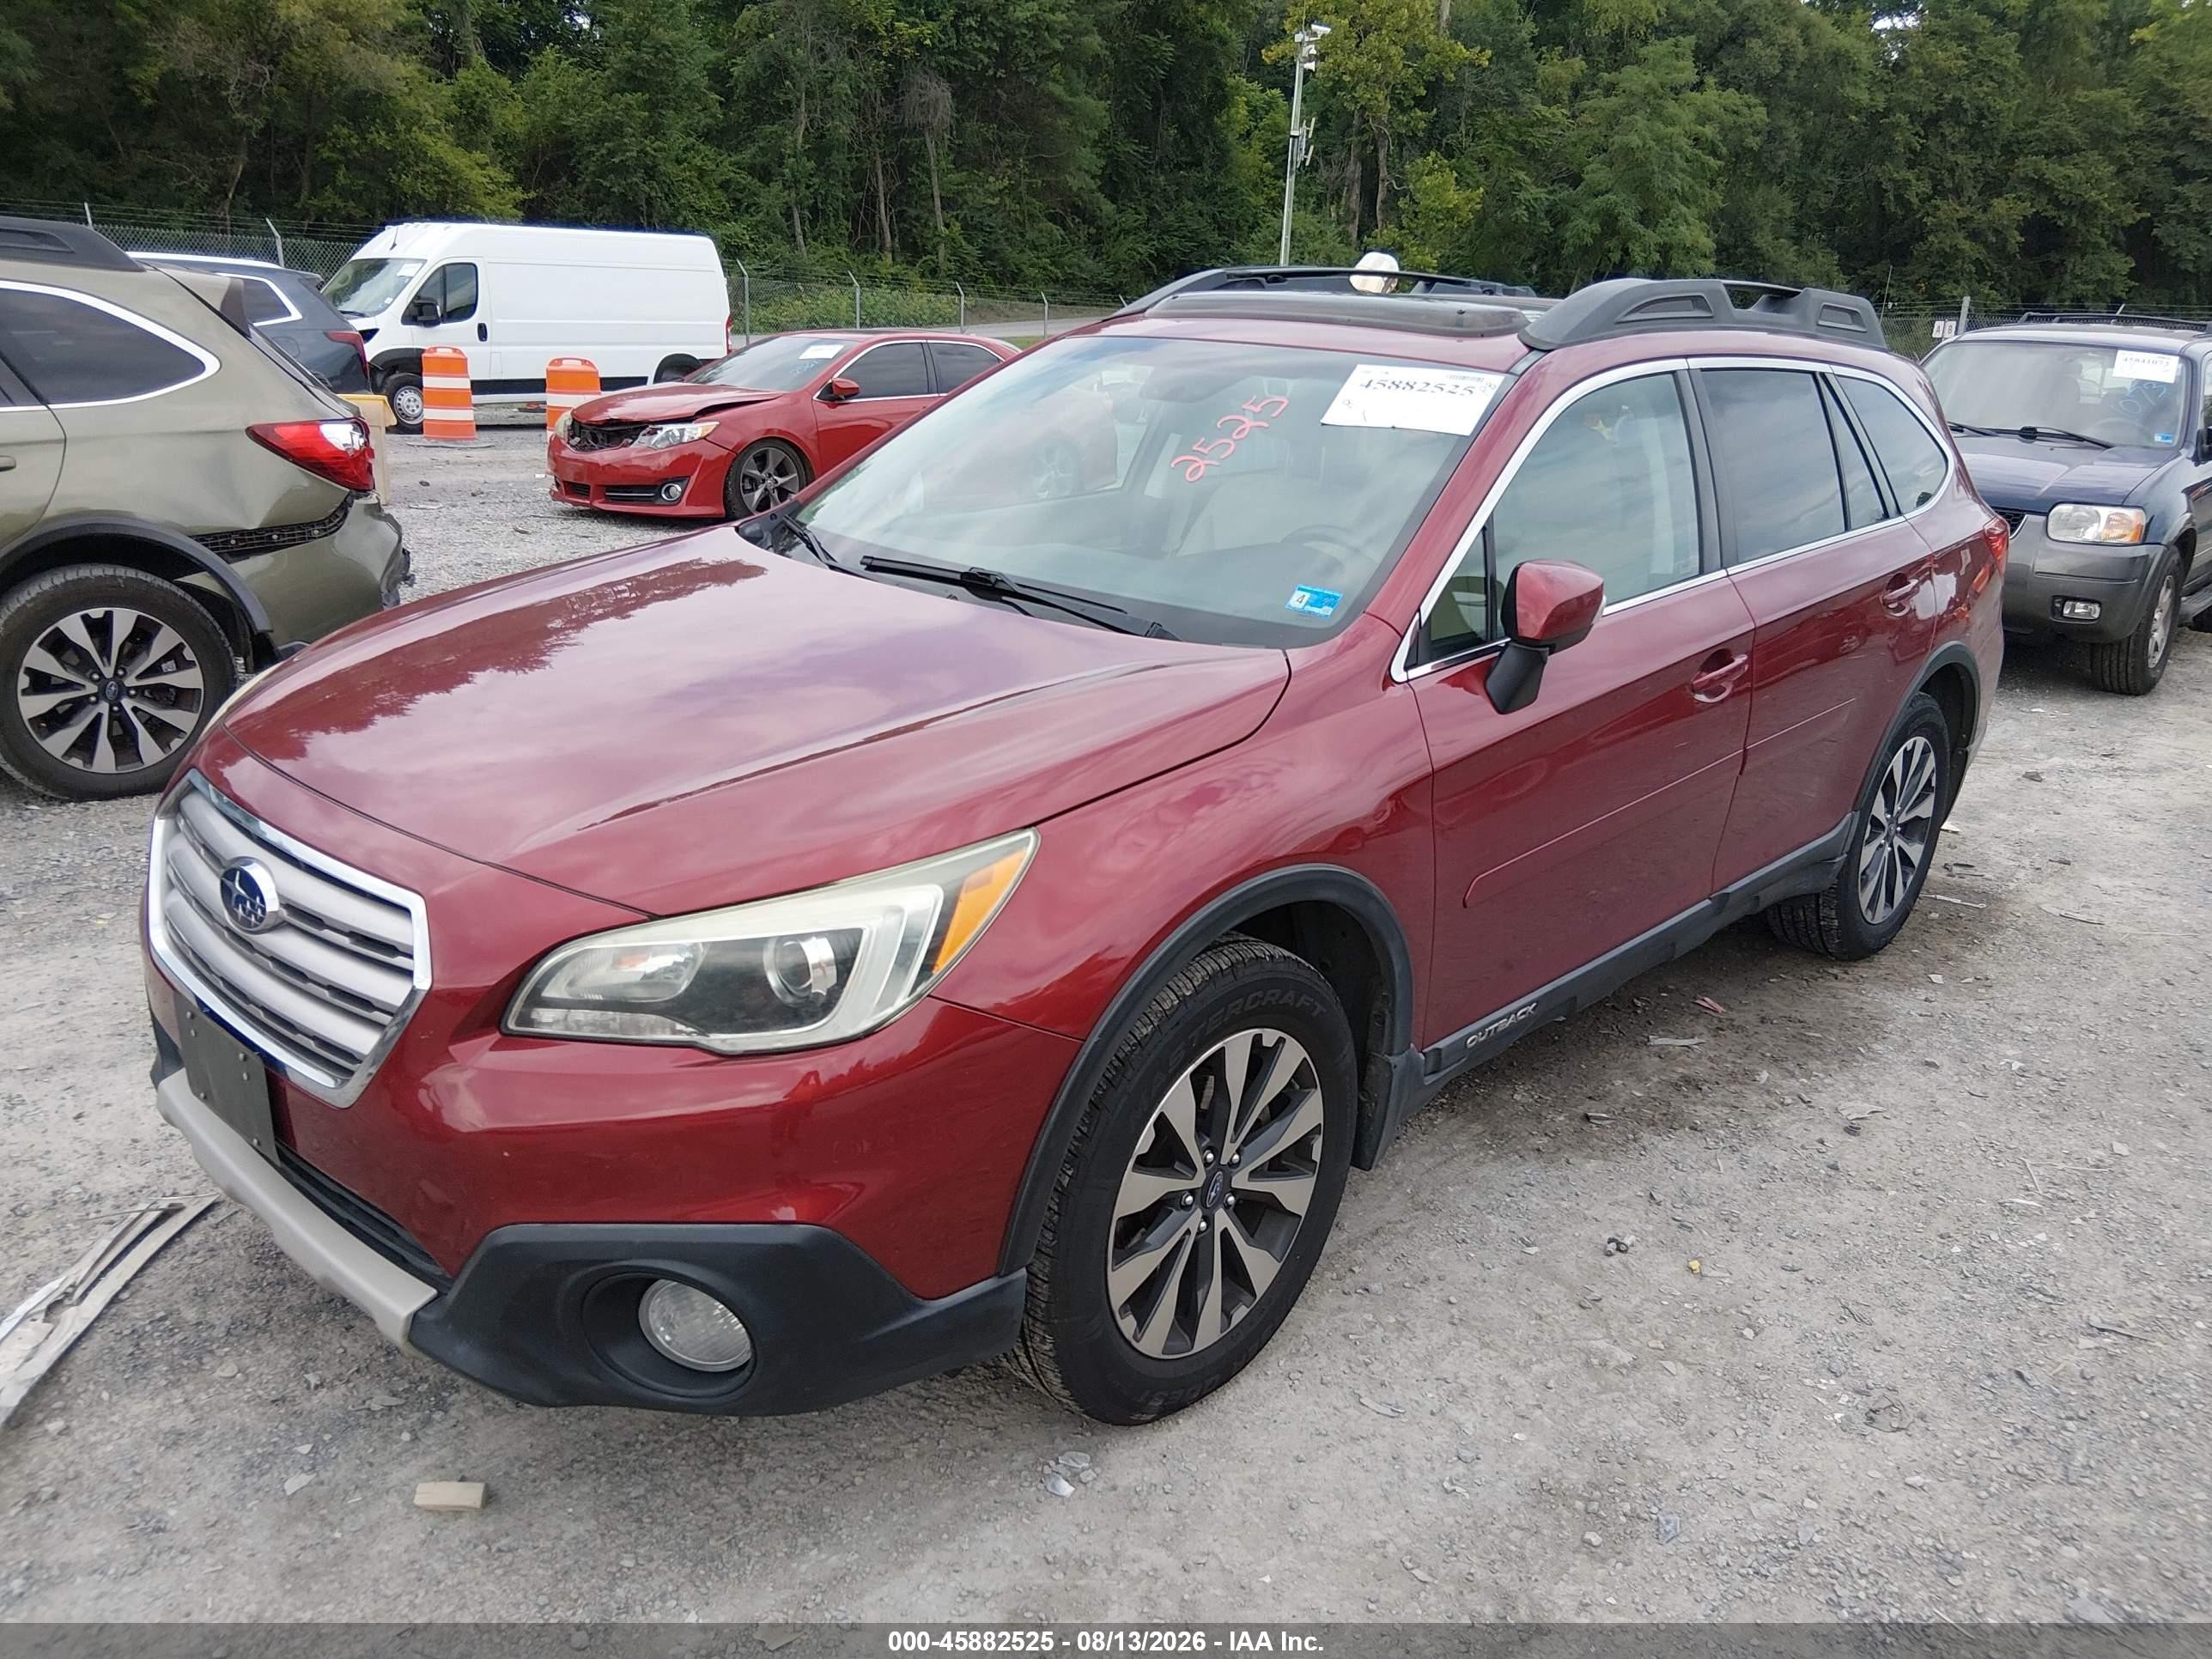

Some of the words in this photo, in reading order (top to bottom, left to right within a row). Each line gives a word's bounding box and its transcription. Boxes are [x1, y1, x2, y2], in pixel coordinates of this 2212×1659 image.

[1360, 378, 1476, 397] 45882525
[1170, 395, 1290, 482] 2525
[1466, 1002, 1537, 1048] OUTBACK
